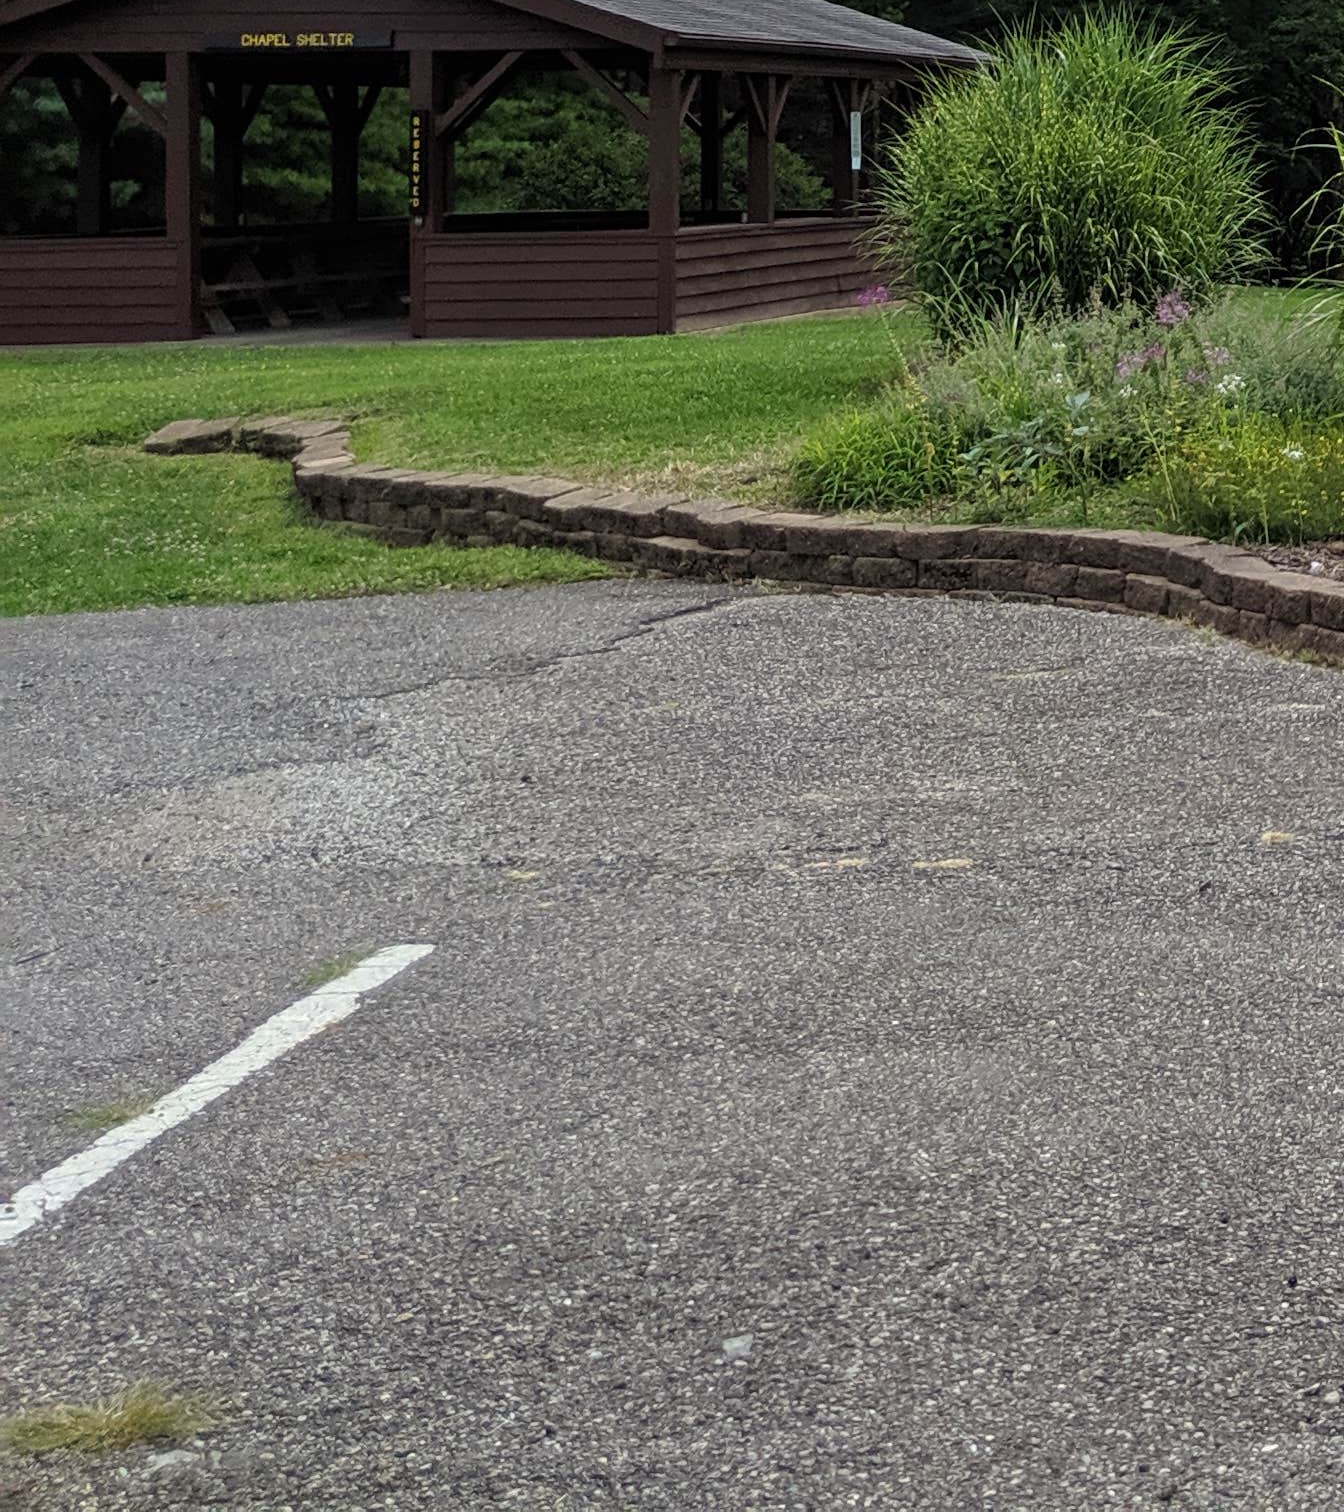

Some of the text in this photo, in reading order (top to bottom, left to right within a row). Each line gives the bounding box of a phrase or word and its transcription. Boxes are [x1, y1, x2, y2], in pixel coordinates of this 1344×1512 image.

[241, 33, 354, 46] CHAPEL SHELTER
[412, 116, 420, 207] RESERVED
